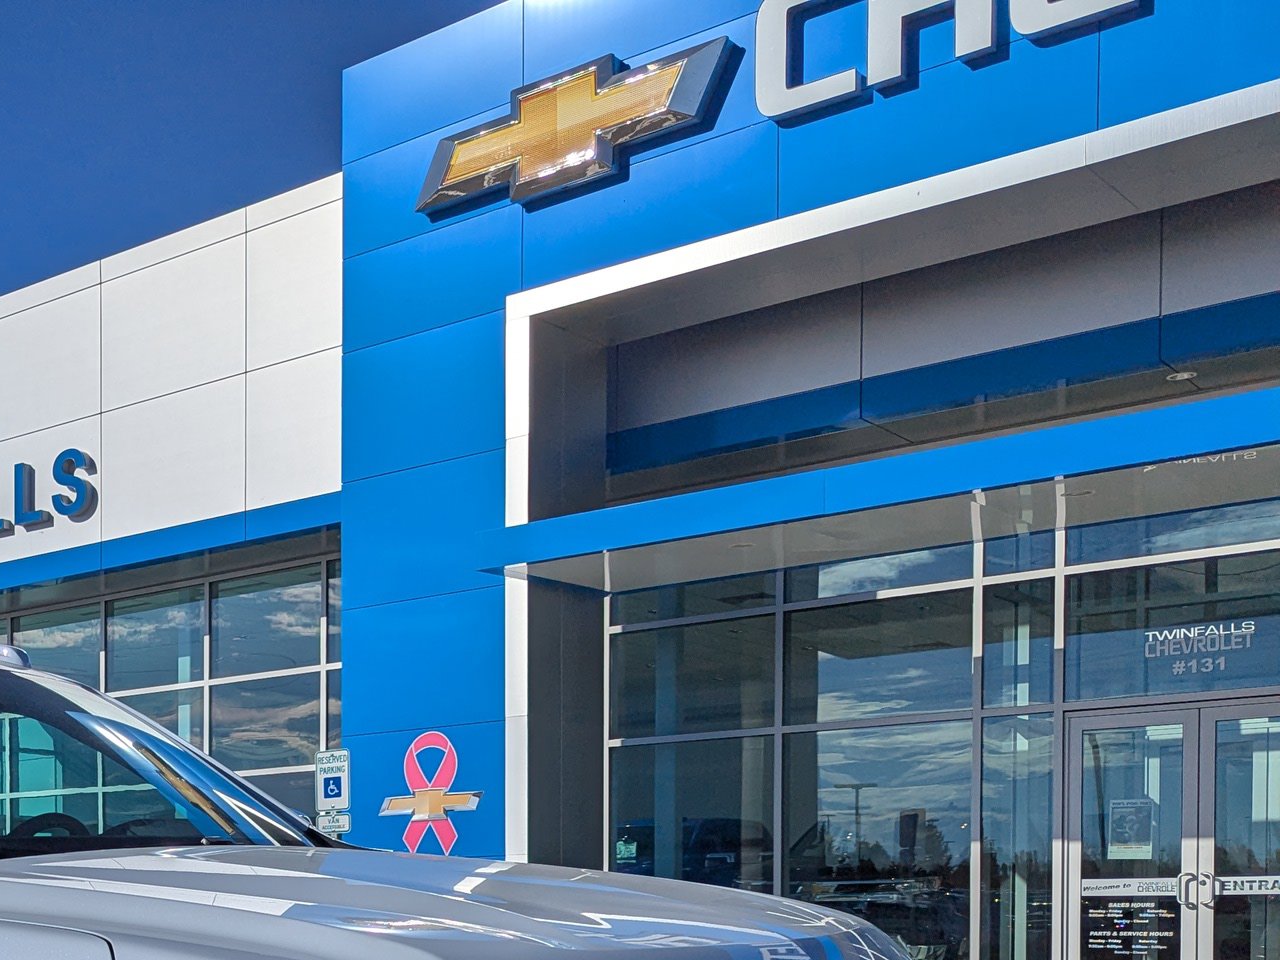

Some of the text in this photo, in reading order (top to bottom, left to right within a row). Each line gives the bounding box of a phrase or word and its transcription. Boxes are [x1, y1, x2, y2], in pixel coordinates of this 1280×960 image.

[1144, 621, 1255, 642] TWINFALLS
[1144, 631, 1255, 658] CHEVROLET
[1172, 656, 1225, 675] #131
[317, 755, 347, 765] RESERVED
[319, 765, 346, 775] PARKING
[1082, 883, 1121, 892] Welcome
